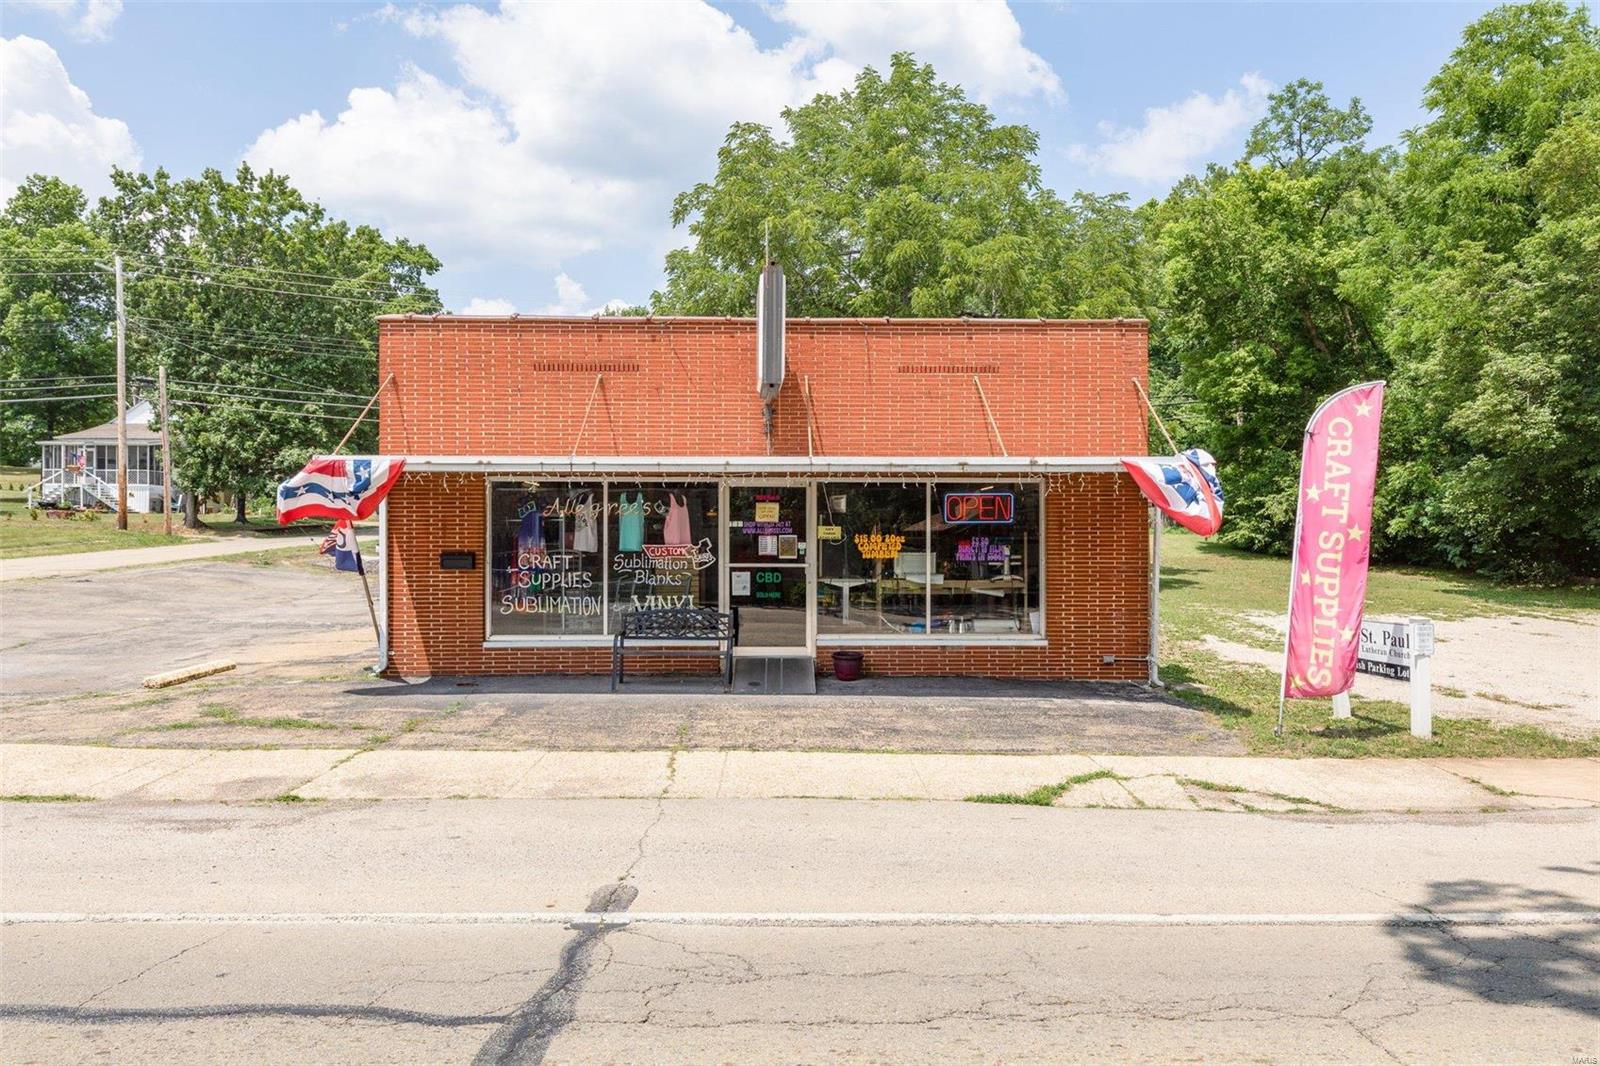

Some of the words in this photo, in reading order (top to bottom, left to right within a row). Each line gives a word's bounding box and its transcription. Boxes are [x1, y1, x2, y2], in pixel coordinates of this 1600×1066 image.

[1321, 416, 1353, 525] CRAFT
[947, 496, 1011, 520] OPEN
[854, 534, 882, 544] $15.00
[648, 547, 685, 556] CUSTOM
[518, 553, 573, 570] CRAFT
[613, 553, 688, 570] Sublimation
[519, 571, 593, 589] SUPPLIES
[634, 570, 682, 586] Blanks
[756, 572, 781, 583] CBD
[500, 595, 602, 616] SUBLIMATION
[1307, 531, 1345, 688] SUPPLIES
[1361, 628, 1376, 644] St.
[1383, 631, 1409, 649] Paul
[1361, 645, 1387, 656] Lutheran
[1389, 649, 1411, 660] Church
[1367, 662, 1395, 677] Parking
[1397, 667, 1410, 678] Lot
